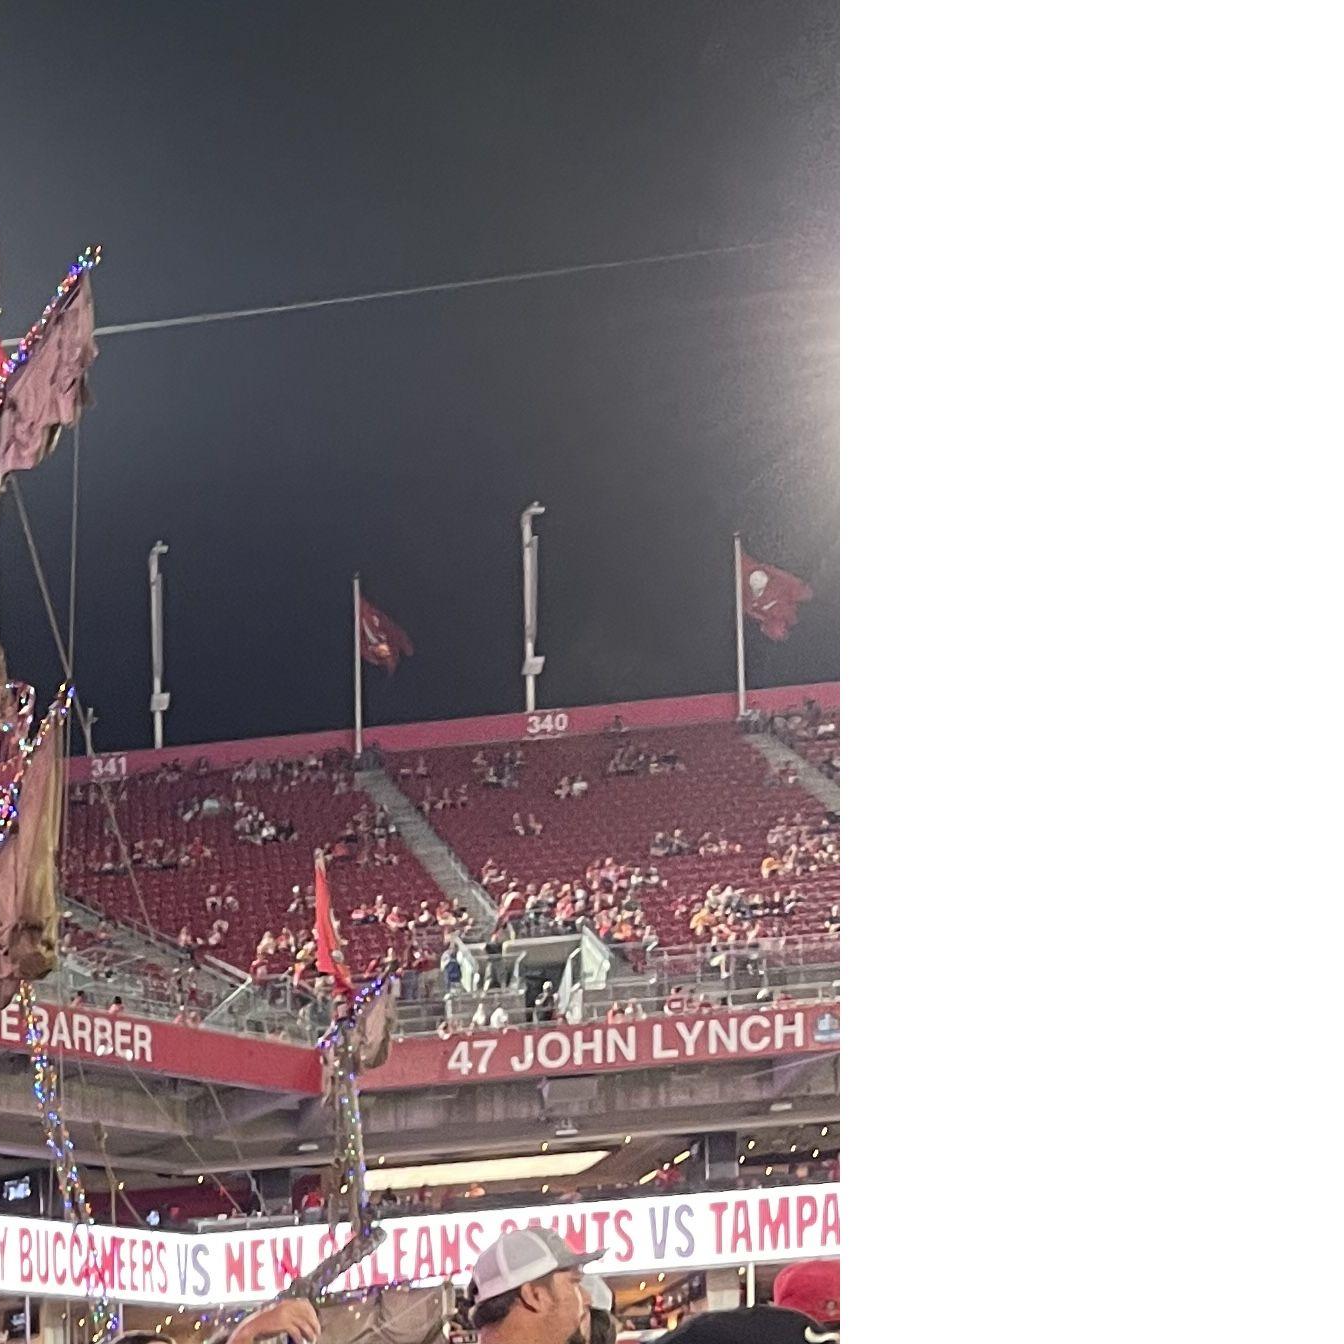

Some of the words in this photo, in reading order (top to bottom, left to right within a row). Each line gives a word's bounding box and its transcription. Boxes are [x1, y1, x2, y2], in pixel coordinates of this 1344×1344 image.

[527, 713, 568, 733] 340
[91, 757, 127, 777] 341
[29, 1005, 153, 1062] BARBER
[447, 1039, 498, 1075] 47
[511, 1026, 636, 1073] JOHN
[652, 1012, 804, 1060] LYNCH
[19, 1227, 168, 1294] BUCCANEERS
[176, 1243, 212, 1297] VS
[225, 1236, 303, 1293] NEW
[649, 1204, 695, 1260] VS
